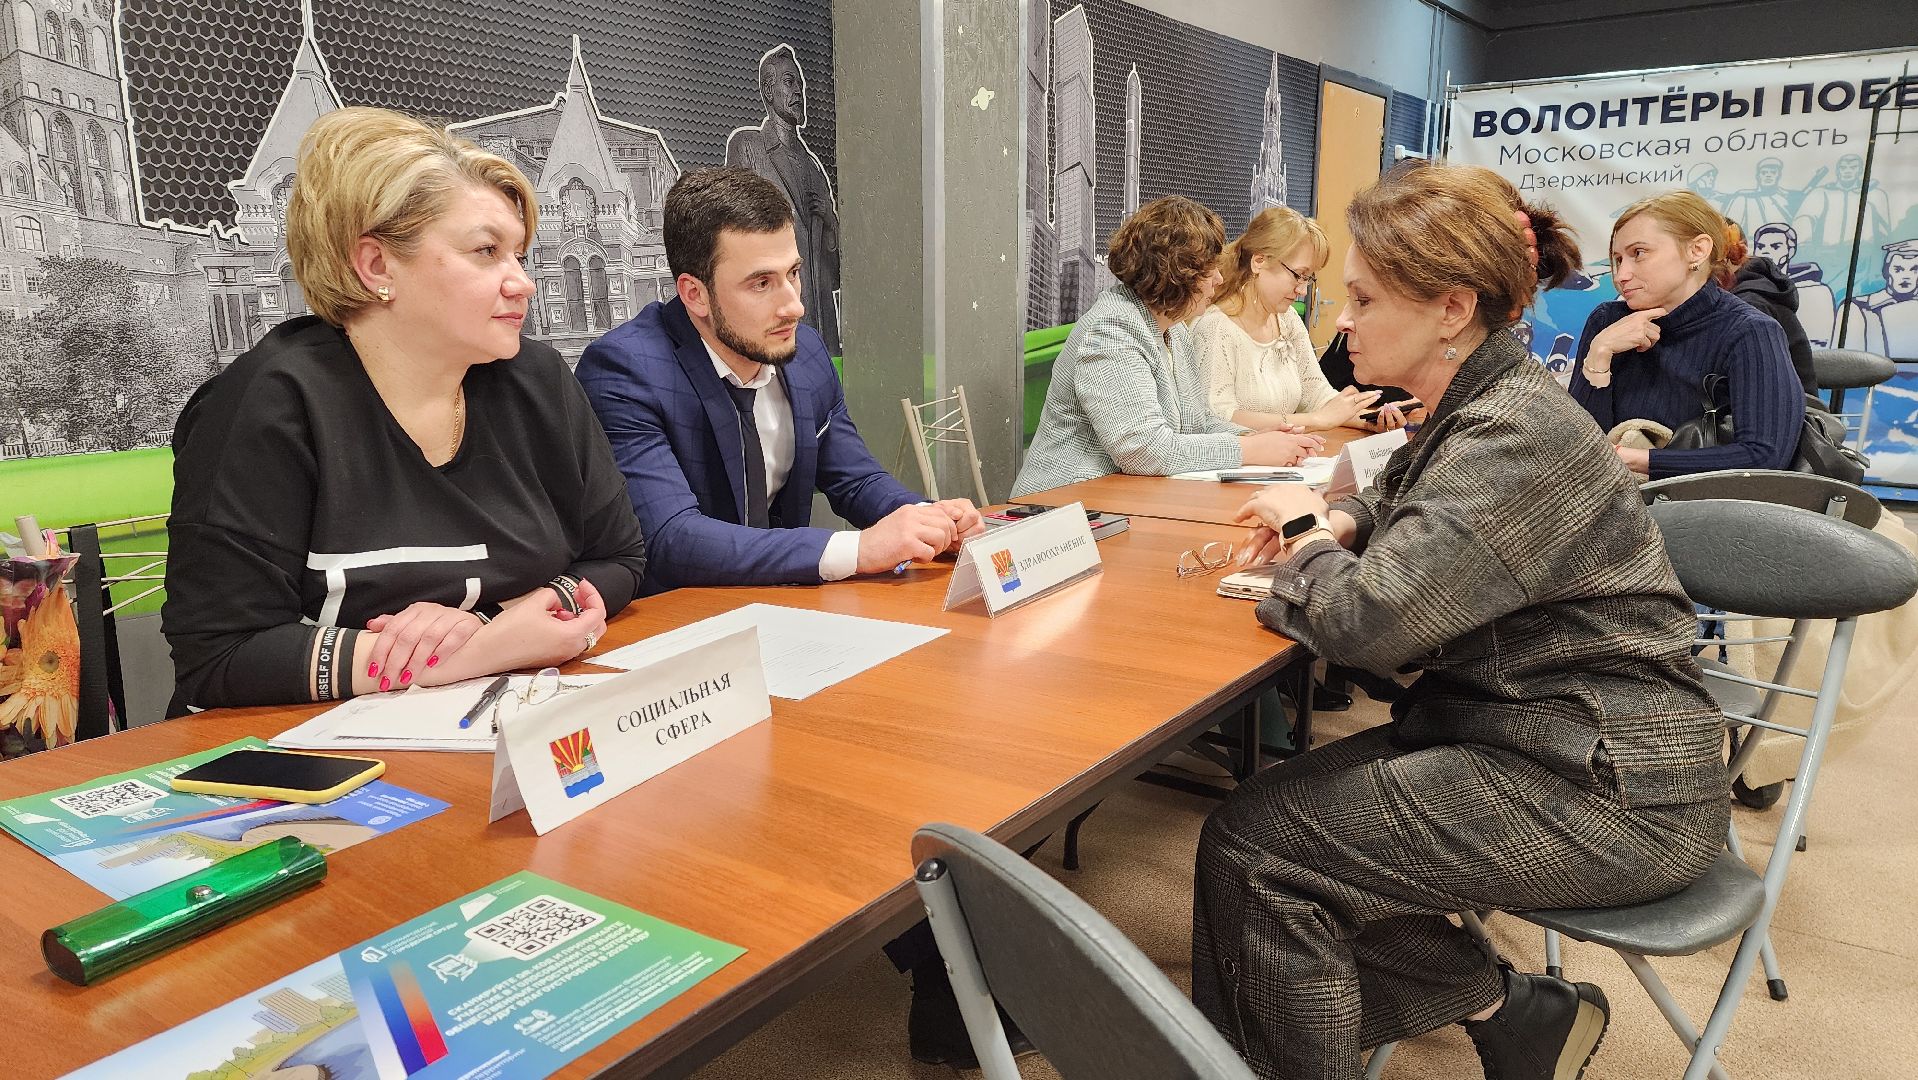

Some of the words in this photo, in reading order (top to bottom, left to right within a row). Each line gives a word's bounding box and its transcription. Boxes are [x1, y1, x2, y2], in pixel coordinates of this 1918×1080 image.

[1472, 85, 1764, 138] ВОЛОНТЁРЫ
[1499, 137, 1690, 166] Московская
[1704, 127, 1848, 153] область
[1519, 164, 1684, 191] Дзержинский
[320, 647, 331, 662] OF
[616, 672, 732, 734] СОЦИАЛЬНАЯ
[655, 710, 712, 746] СФЕРА
